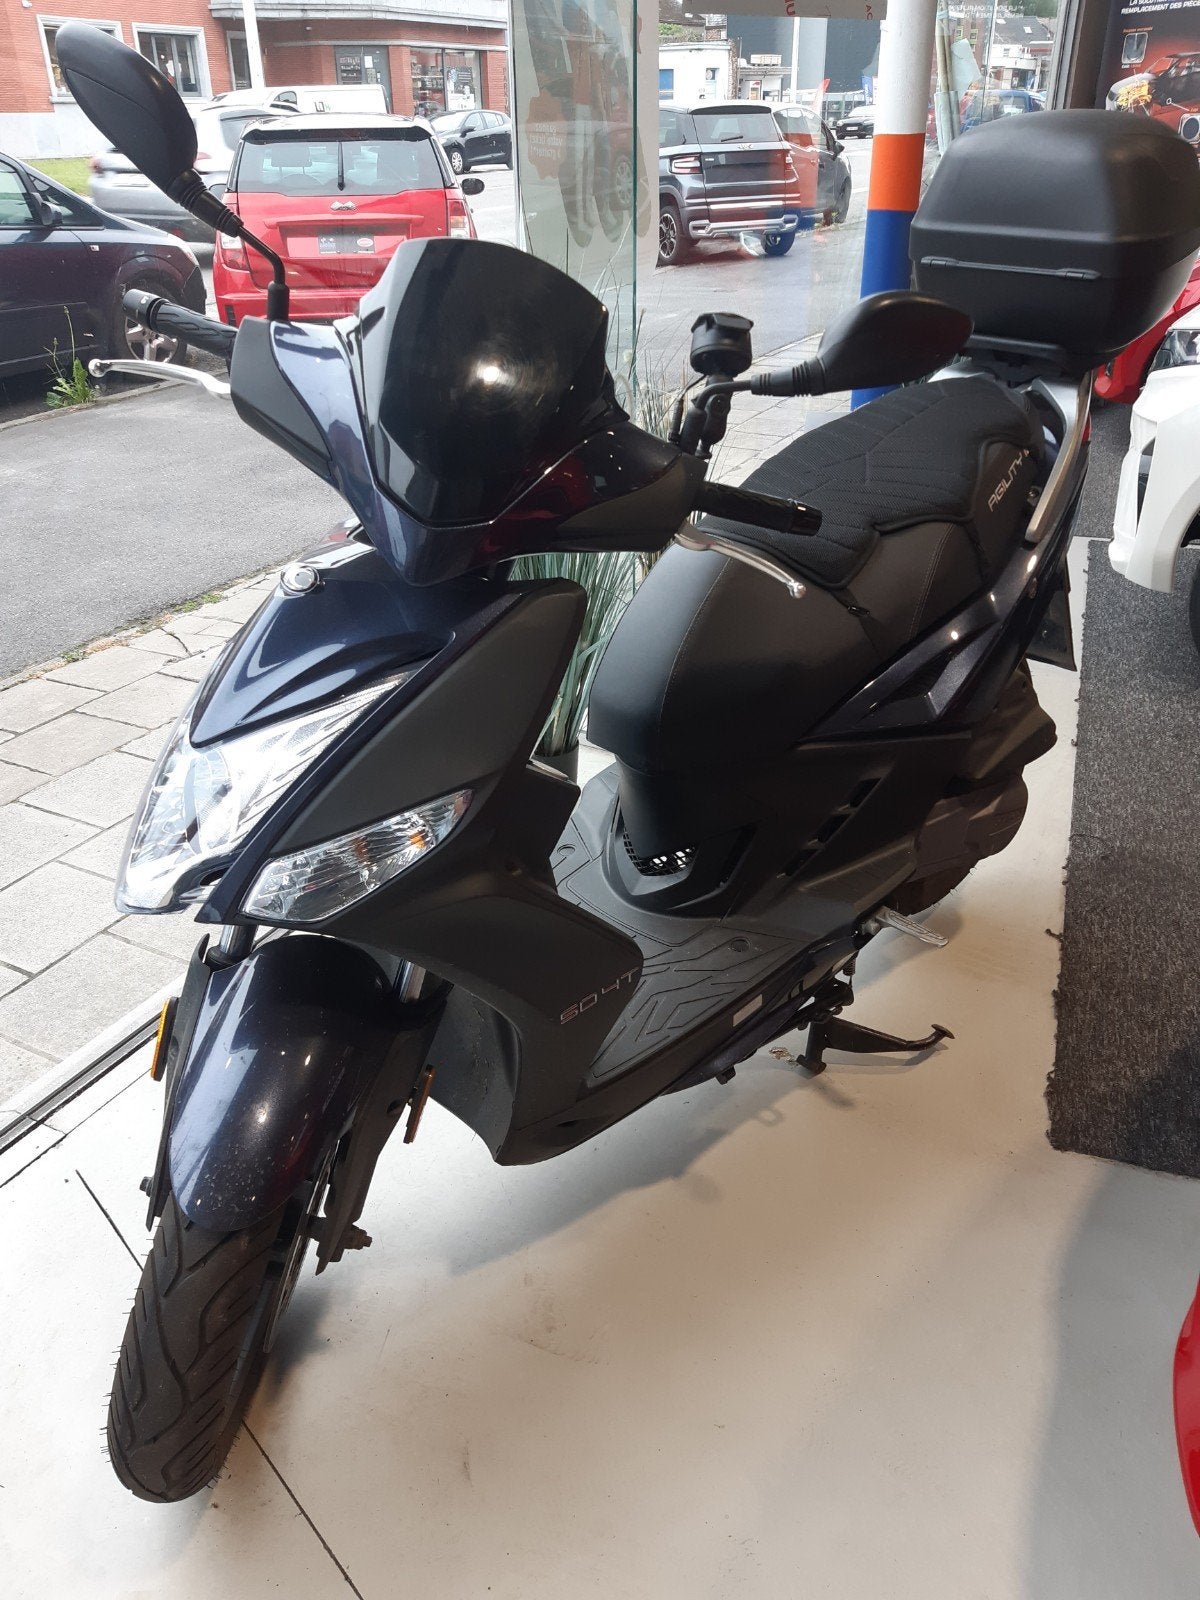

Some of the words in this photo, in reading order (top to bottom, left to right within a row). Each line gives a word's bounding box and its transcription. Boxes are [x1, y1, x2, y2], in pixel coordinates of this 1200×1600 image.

[1121, 3, 1169, 15] REMPLACEMENT
[1169, 2, 1182, 10] DES
[987, 451, 1023, 513] AGILITY
[560, 992, 598, 1025] 50
[601, 966, 639, 995] 4T
